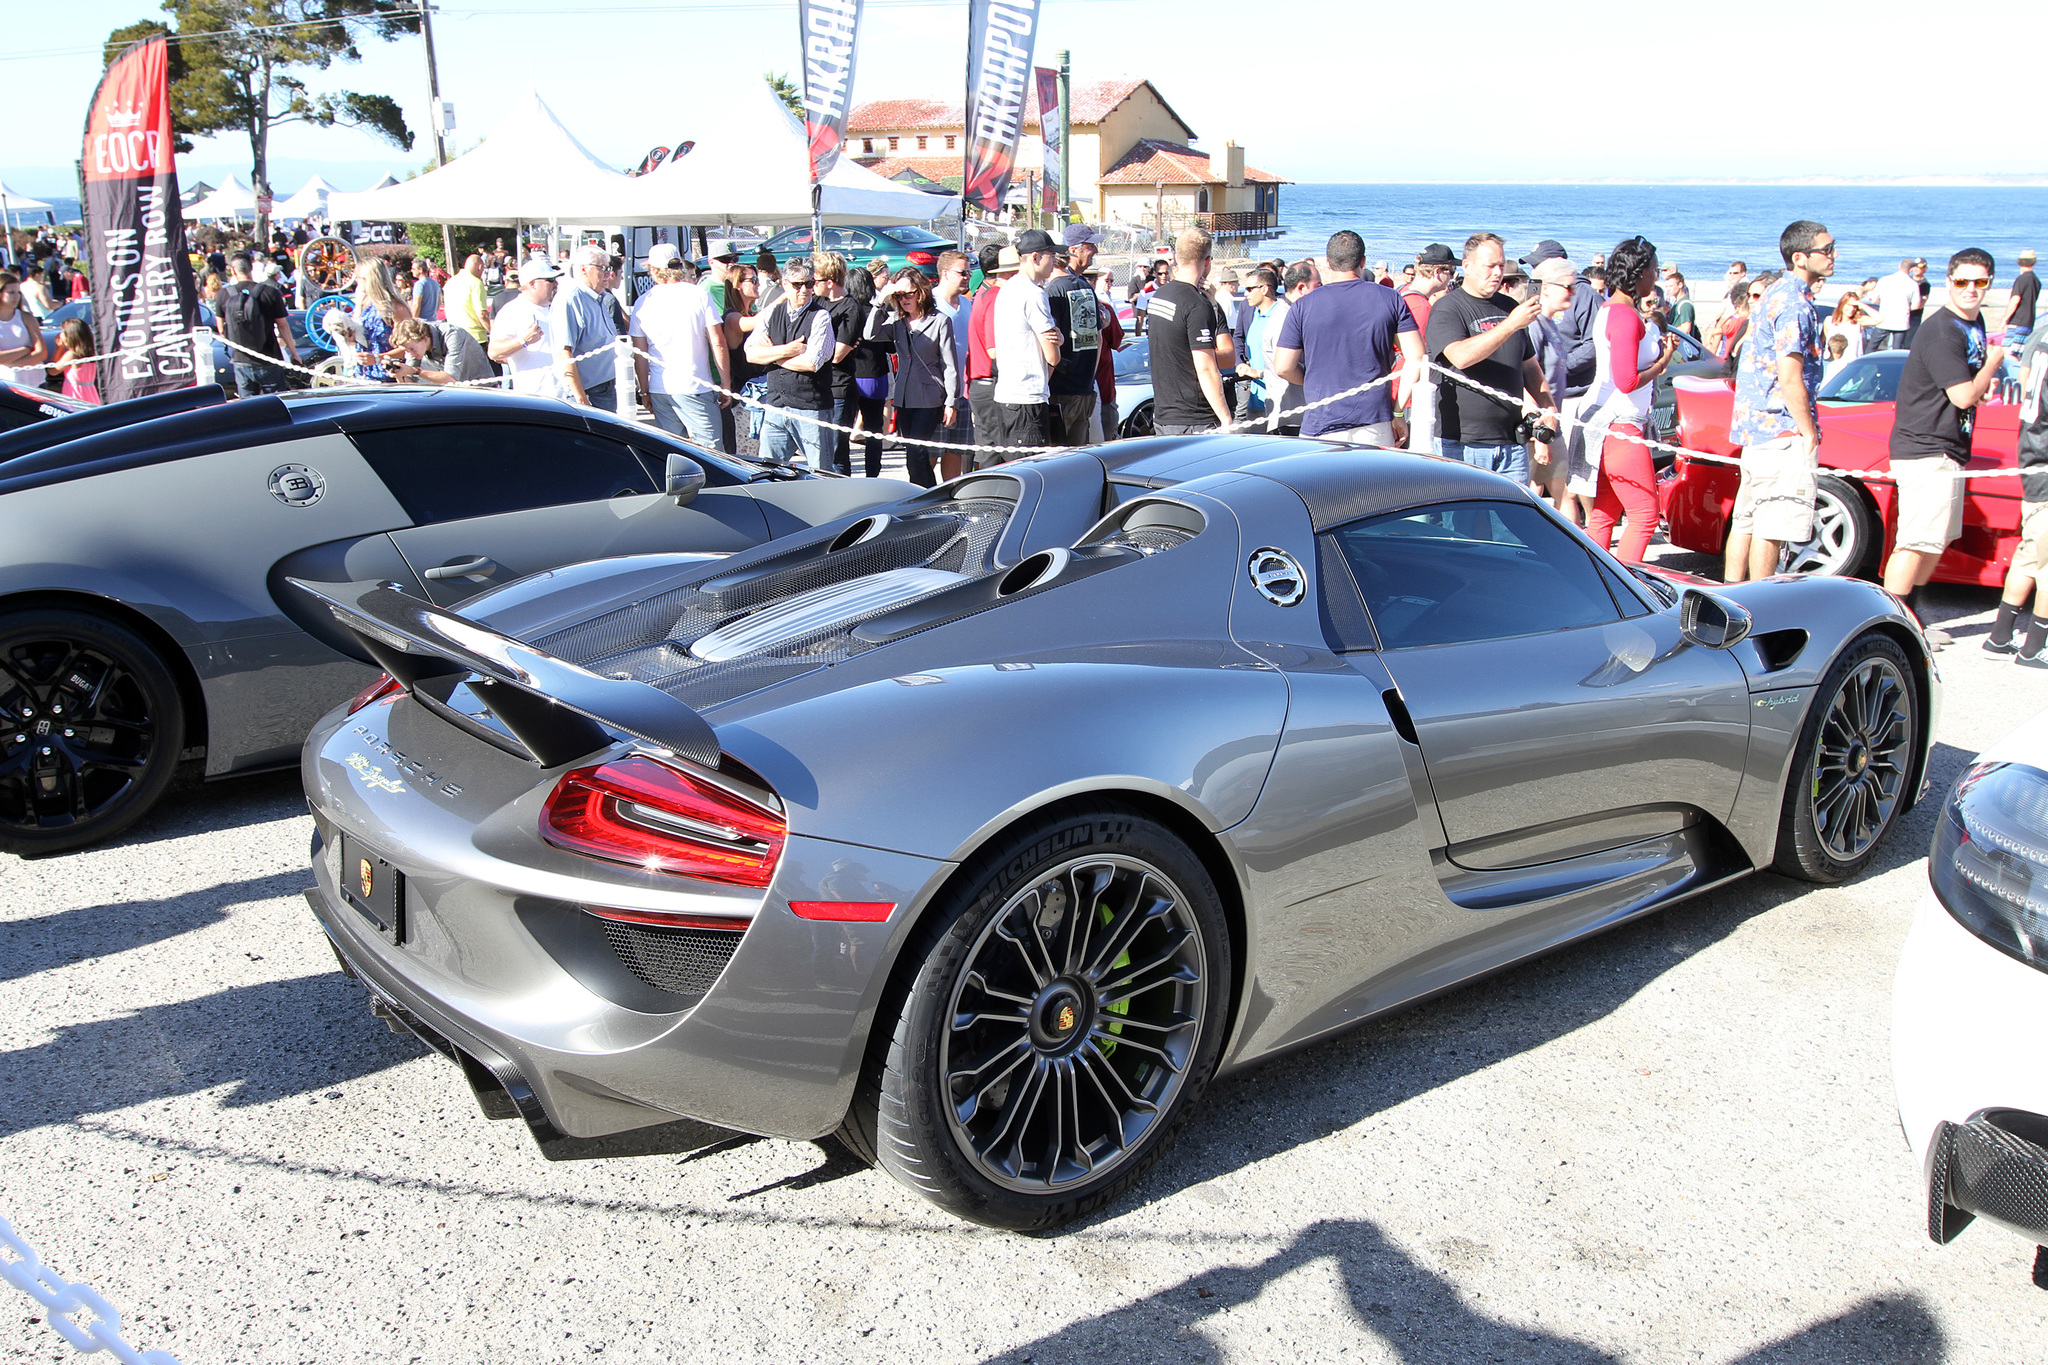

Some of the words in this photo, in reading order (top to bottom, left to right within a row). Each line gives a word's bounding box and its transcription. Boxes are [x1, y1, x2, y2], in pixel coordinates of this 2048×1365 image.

[975, 0, 1037, 147] AKRAPO
[103, 228, 141, 267] ON
[136, 185, 168, 247] ROW
[110, 272, 154, 380] EXOTICS
[144, 253, 195, 376] CANNERY
[352, 725, 465, 799] PORSCHE
[978, 822, 1092, 913] MICHELIN
